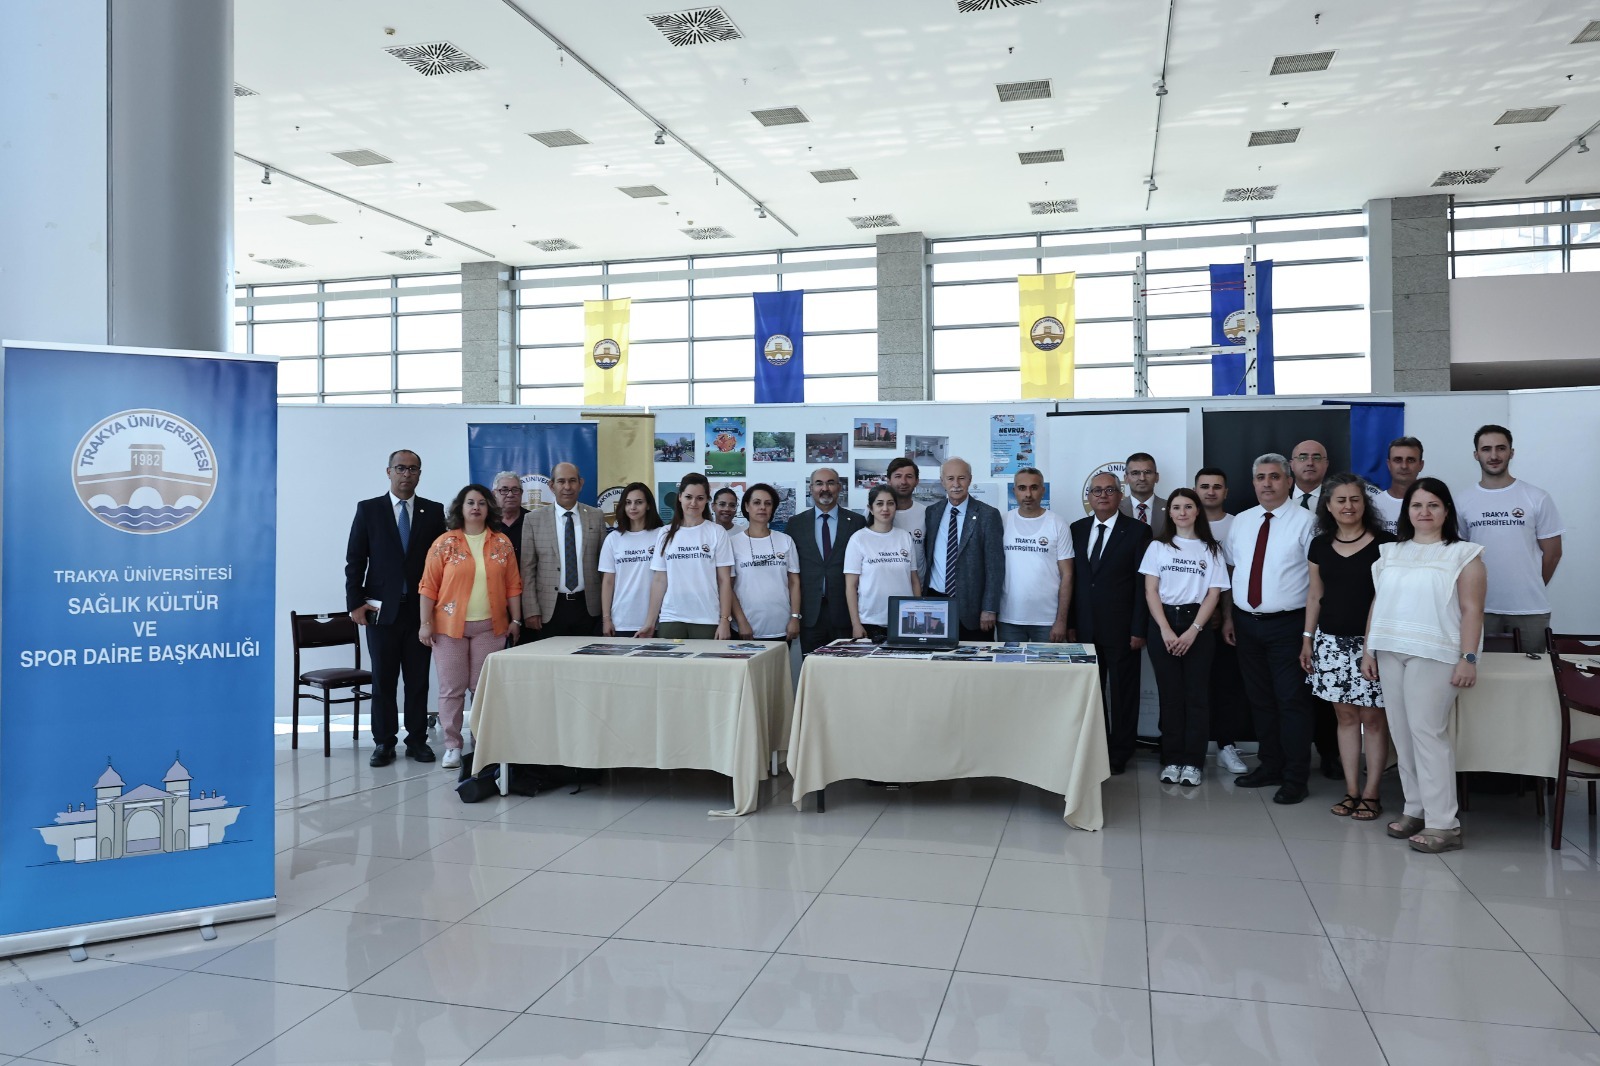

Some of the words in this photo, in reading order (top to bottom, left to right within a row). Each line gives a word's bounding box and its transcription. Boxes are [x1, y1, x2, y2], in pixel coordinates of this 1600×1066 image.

[80, 421, 127, 467] TRAKYA
[127, 414, 213, 472] ÜNİVERSİTESİ
[132, 453, 161, 467] 1982
[1015, 537, 1037, 545] TRAKYA
[1172, 557, 1197, 566] TRAKYA
[53, 569, 119, 583] TRAKYA
[124, 564, 232, 582] ÜNİVERSİTESİ
[68, 592, 141, 615] SAĞLIK
[147, 590, 219, 612] KÜLTÜR
[132, 620, 157, 638] VE
[20, 649, 77, 668] SPOR
[83, 643, 143, 665] DAİRE
[148, 637, 260, 665] BAŞKANLIĞI
